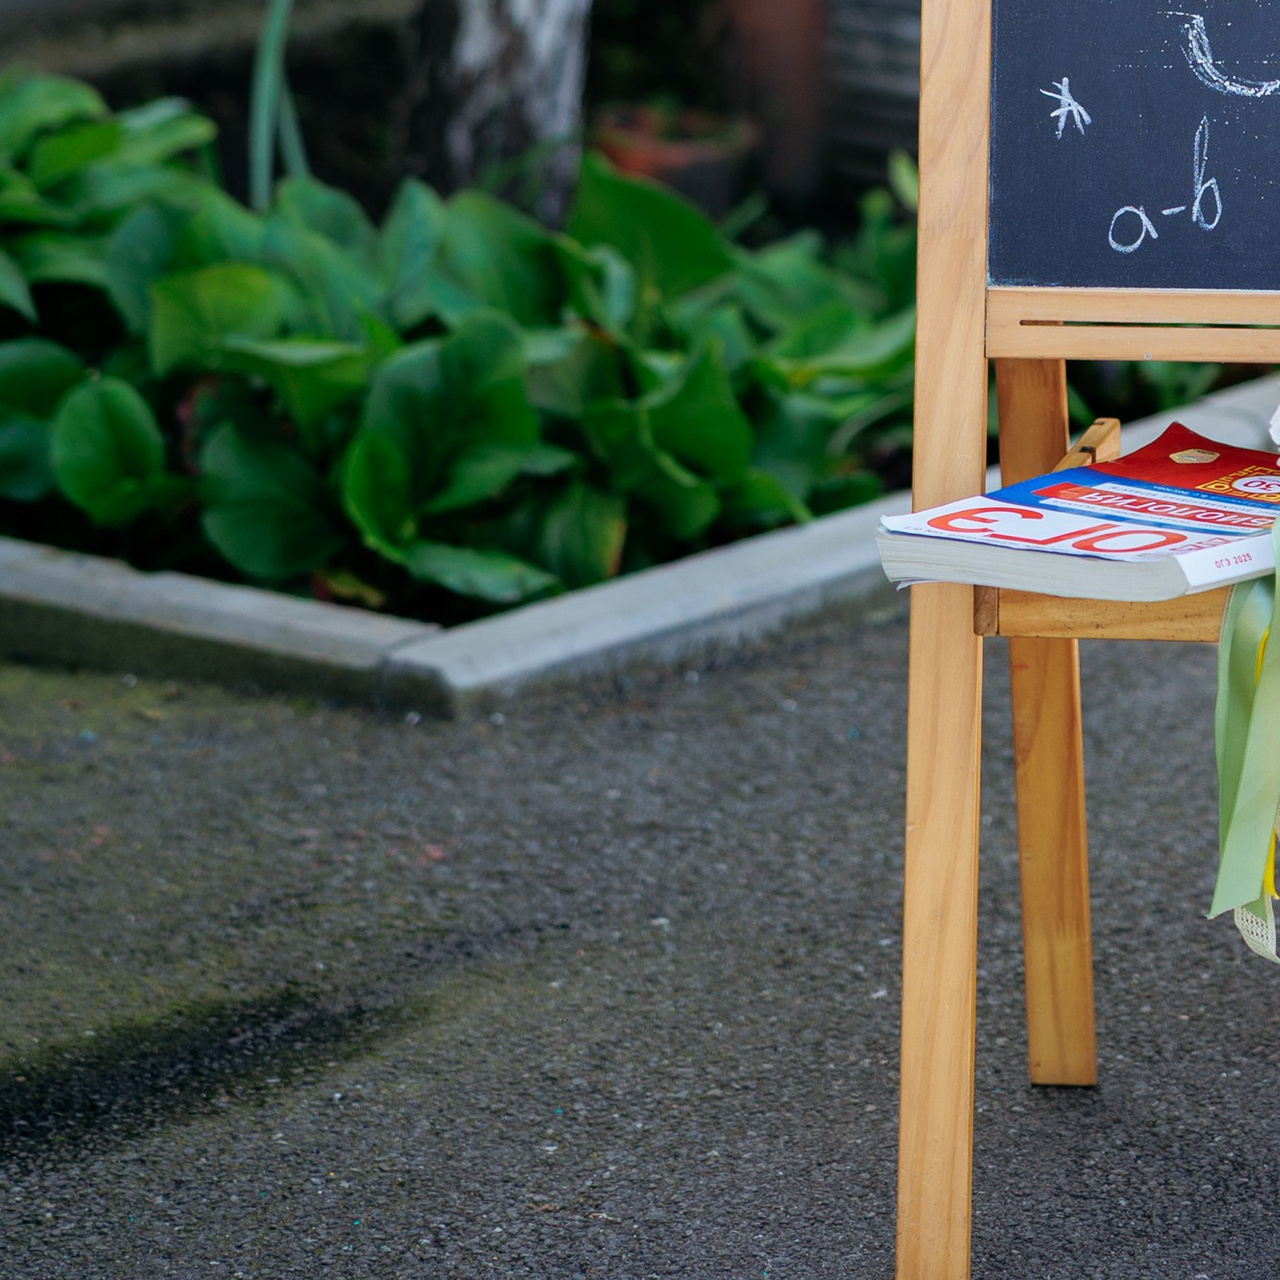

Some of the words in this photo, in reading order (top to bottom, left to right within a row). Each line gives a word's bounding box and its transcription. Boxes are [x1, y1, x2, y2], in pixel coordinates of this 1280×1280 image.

[1077, 492, 1274, 526] БИОЛОГИЯ
[926, 506, 1188, 554] ОГЭ
[1214, 558, 1232, 569] ОГЭ
[1232, 552, 1253, 564] 2025
